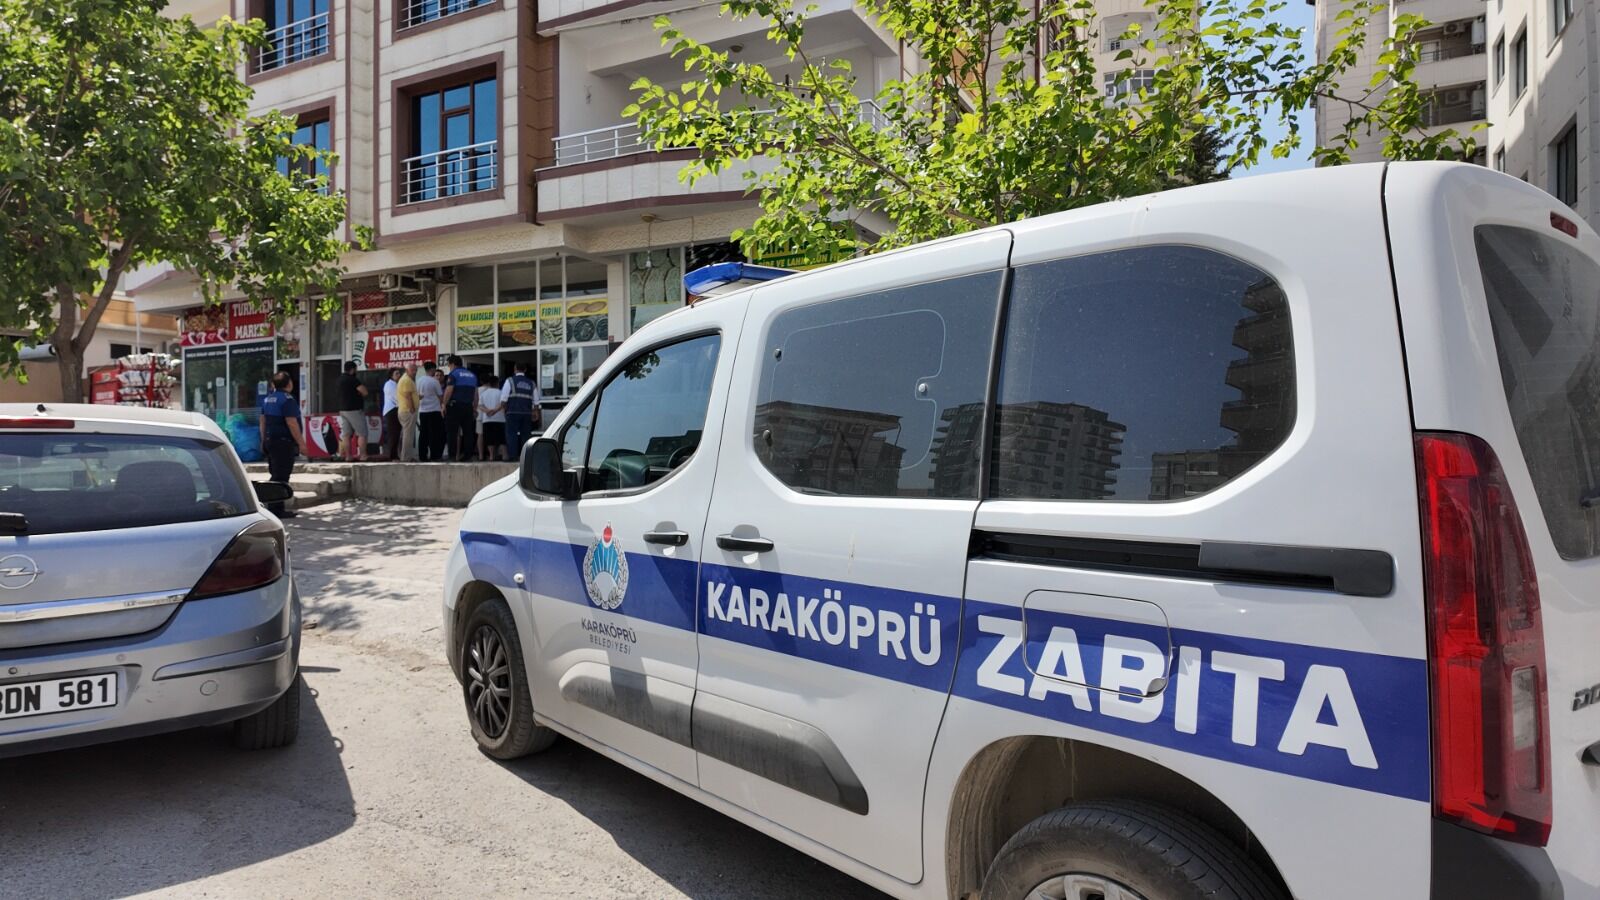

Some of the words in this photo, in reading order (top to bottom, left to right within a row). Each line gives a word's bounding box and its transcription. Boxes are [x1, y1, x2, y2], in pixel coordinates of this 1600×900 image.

[373, 332, 436, 351] TÜRKMEN
[389, 350, 420, 361] MARKET
[581, 617, 637, 644] KARAKÖPRÜ
[708, 581, 941, 666] KARAKÖPRÜ
[0, 685, 41, 715] DN
[59, 677, 108, 707] 581
[976, 614, 1379, 770] ZABITA
